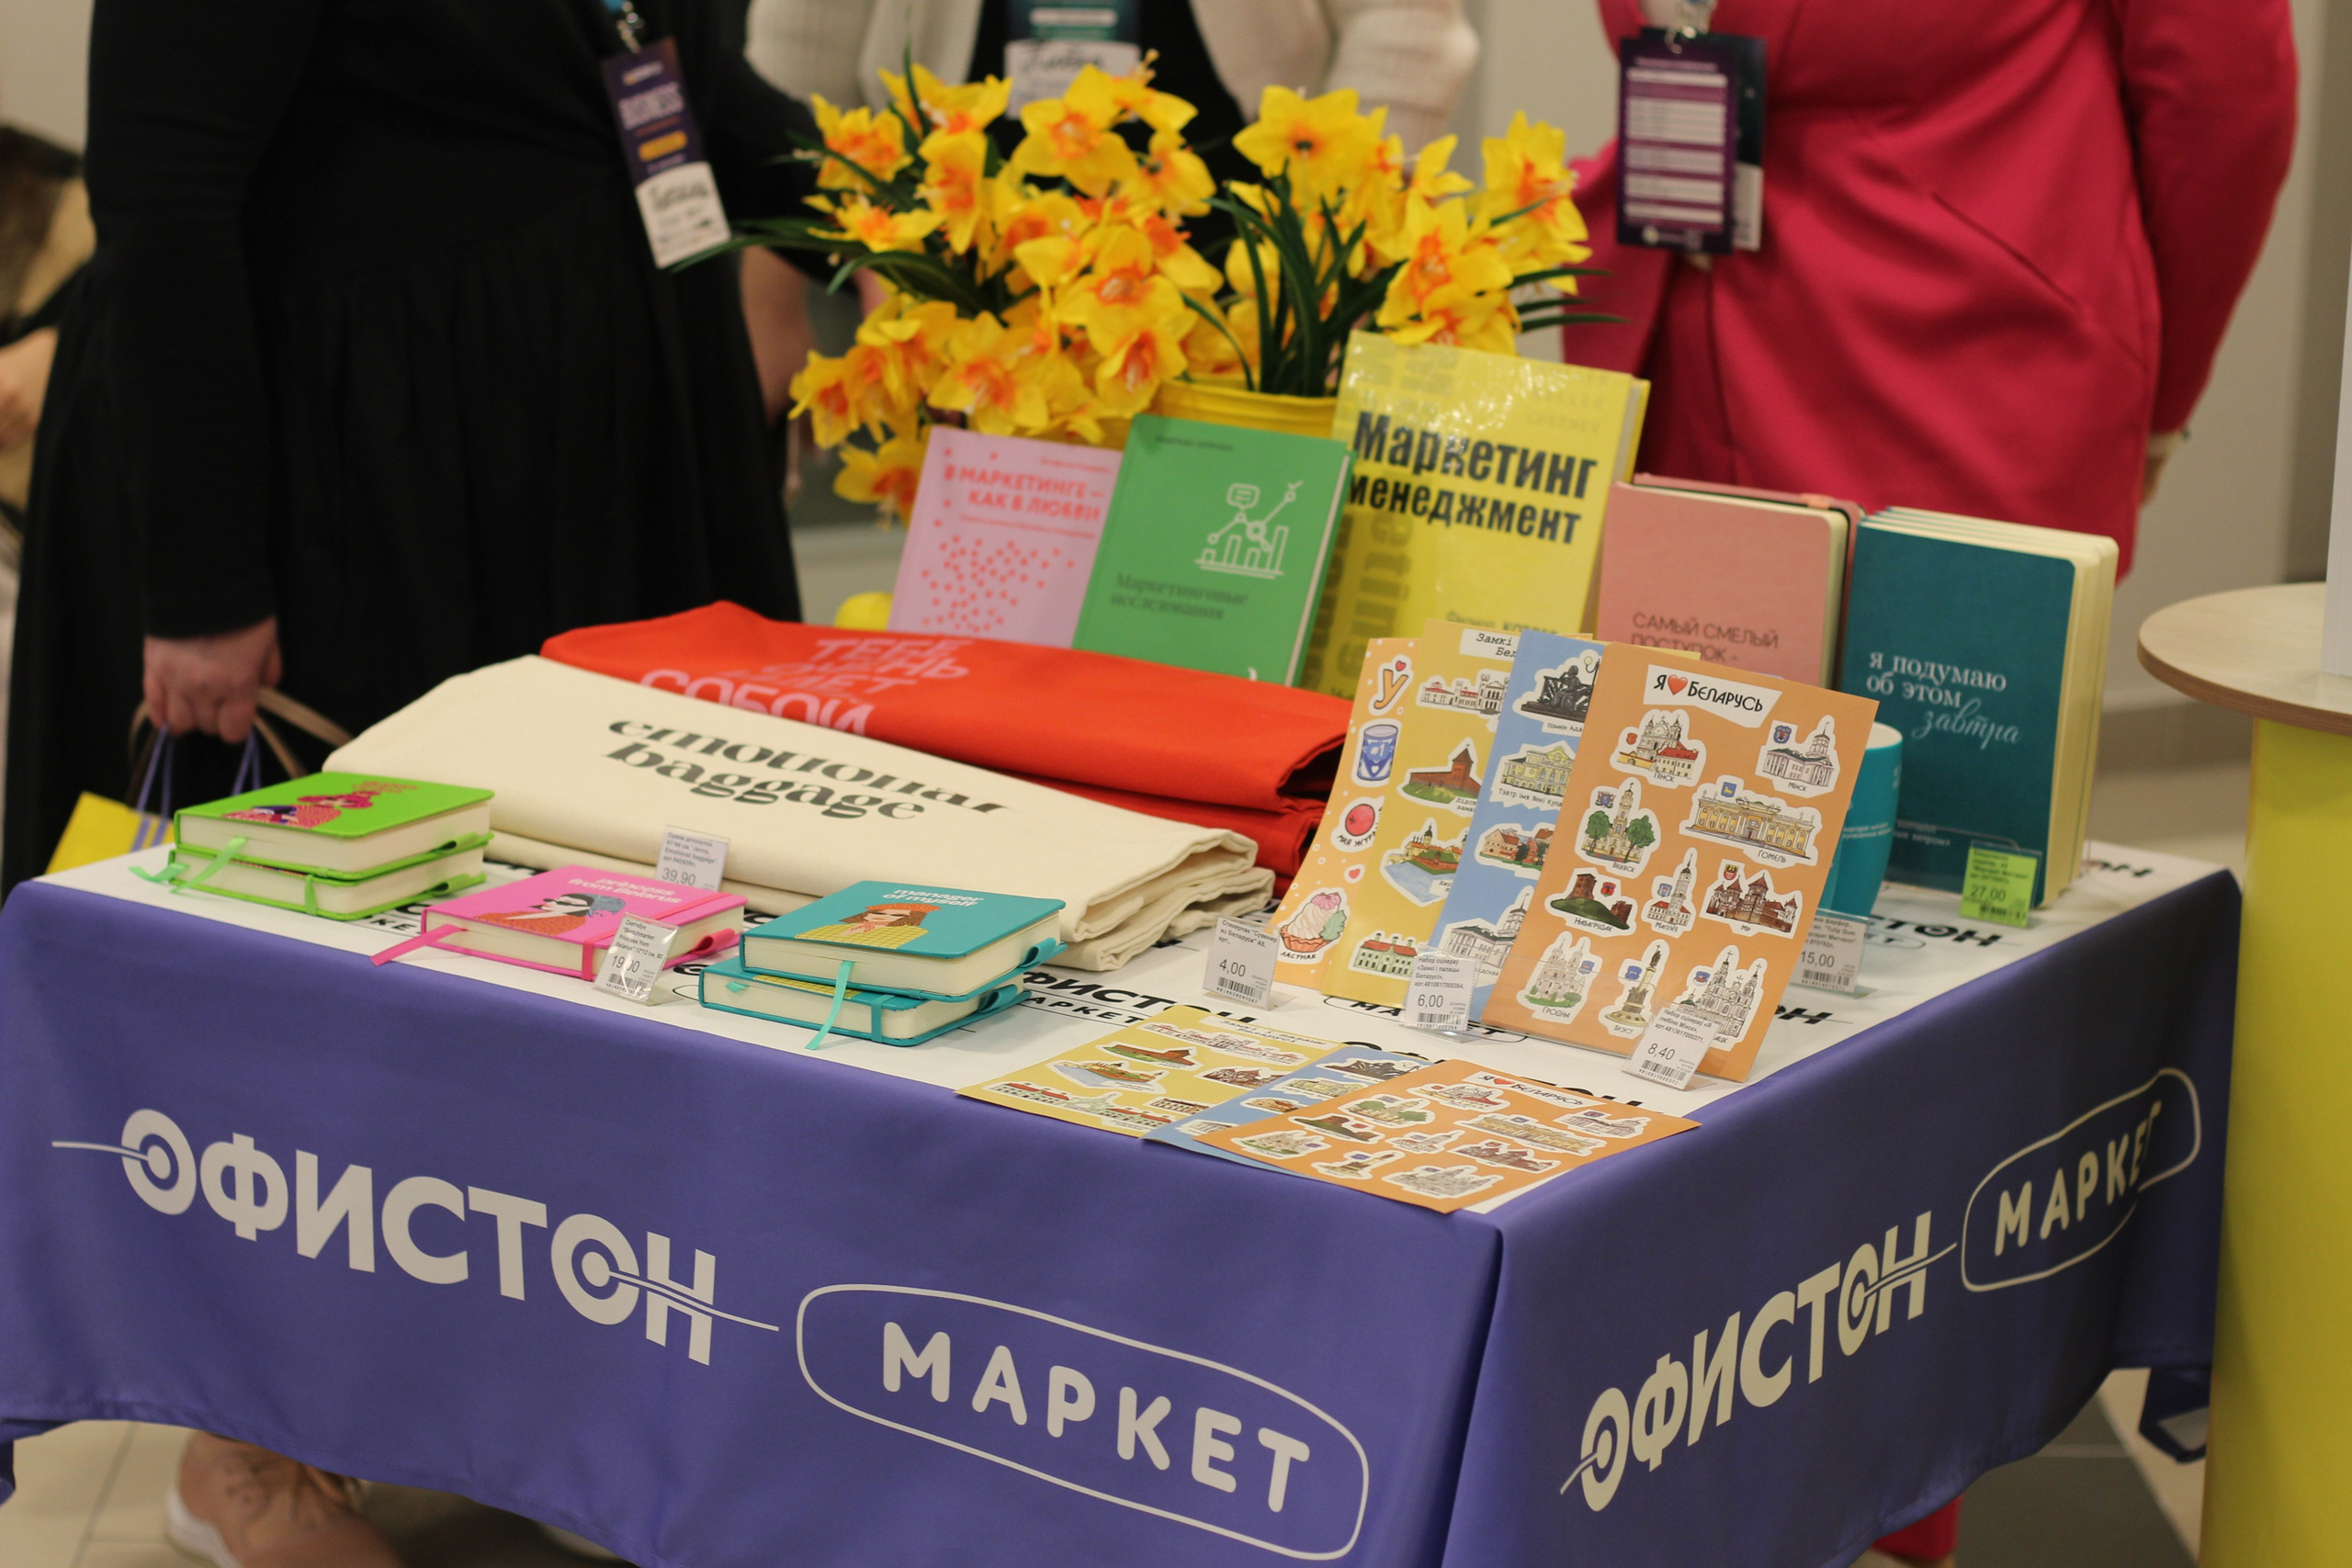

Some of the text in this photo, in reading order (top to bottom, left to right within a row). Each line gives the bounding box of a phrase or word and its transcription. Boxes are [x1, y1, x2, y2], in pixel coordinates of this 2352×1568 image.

[1353, 410, 1599, 500] Маркетинг
[944, 464, 956, 481] В
[958, 466, 1088, 500] МАРКЕТИНГЕ
[968, 489, 1102, 523] КАК В ЛЮБВИ
[1349, 474, 1581, 545] менеджмент
[1476, 632, 1512, 647] Замкі
[1633, 612, 1780, 649] САМЫЙ СМЕЛЫЙ
[1893, 655, 2008, 692] подумаю
[1653, 674, 1764, 713] Я БЕЛАРУСЬ
[1866, 671, 1962, 708] об этом
[1910, 696, 2021, 751] завтра
[1370, 734, 1385, 758] #1
[602, 742, 925, 820] baggage
[594, 878, 676, 897] princess
[662, 867, 696, 886] 39,90
[569, 878, 682, 904] from Belarus
[893, 889, 985, 902] manager
[904, 896, 979, 908] myself
[1222, 919, 1250, 934] Стикерпак
[1227, 930, 1258, 944] Беларуси"
[611, 954, 641, 974] 1900
[1219, 958, 1247, 977] 4,00
[1418, 956, 1435, 964] Набор
[1801, 950, 1835, 968] 15,00
[1025, 996, 1146, 1024] АРКЕТ
[1418, 993, 1444, 1010] 6,00
[1664, 1009, 1680, 1020] Набор
[1647, 1043, 1676, 1061] 8,40
[1994, 1100, 2163, 1258] МАРКЕТ
[120, 1108, 716, 1367] ОФИСТОН
[1579, 1210, 1933, 1512] ОФИСТОН
[881, 1321, 1311, 1515] МАРКЕТ
